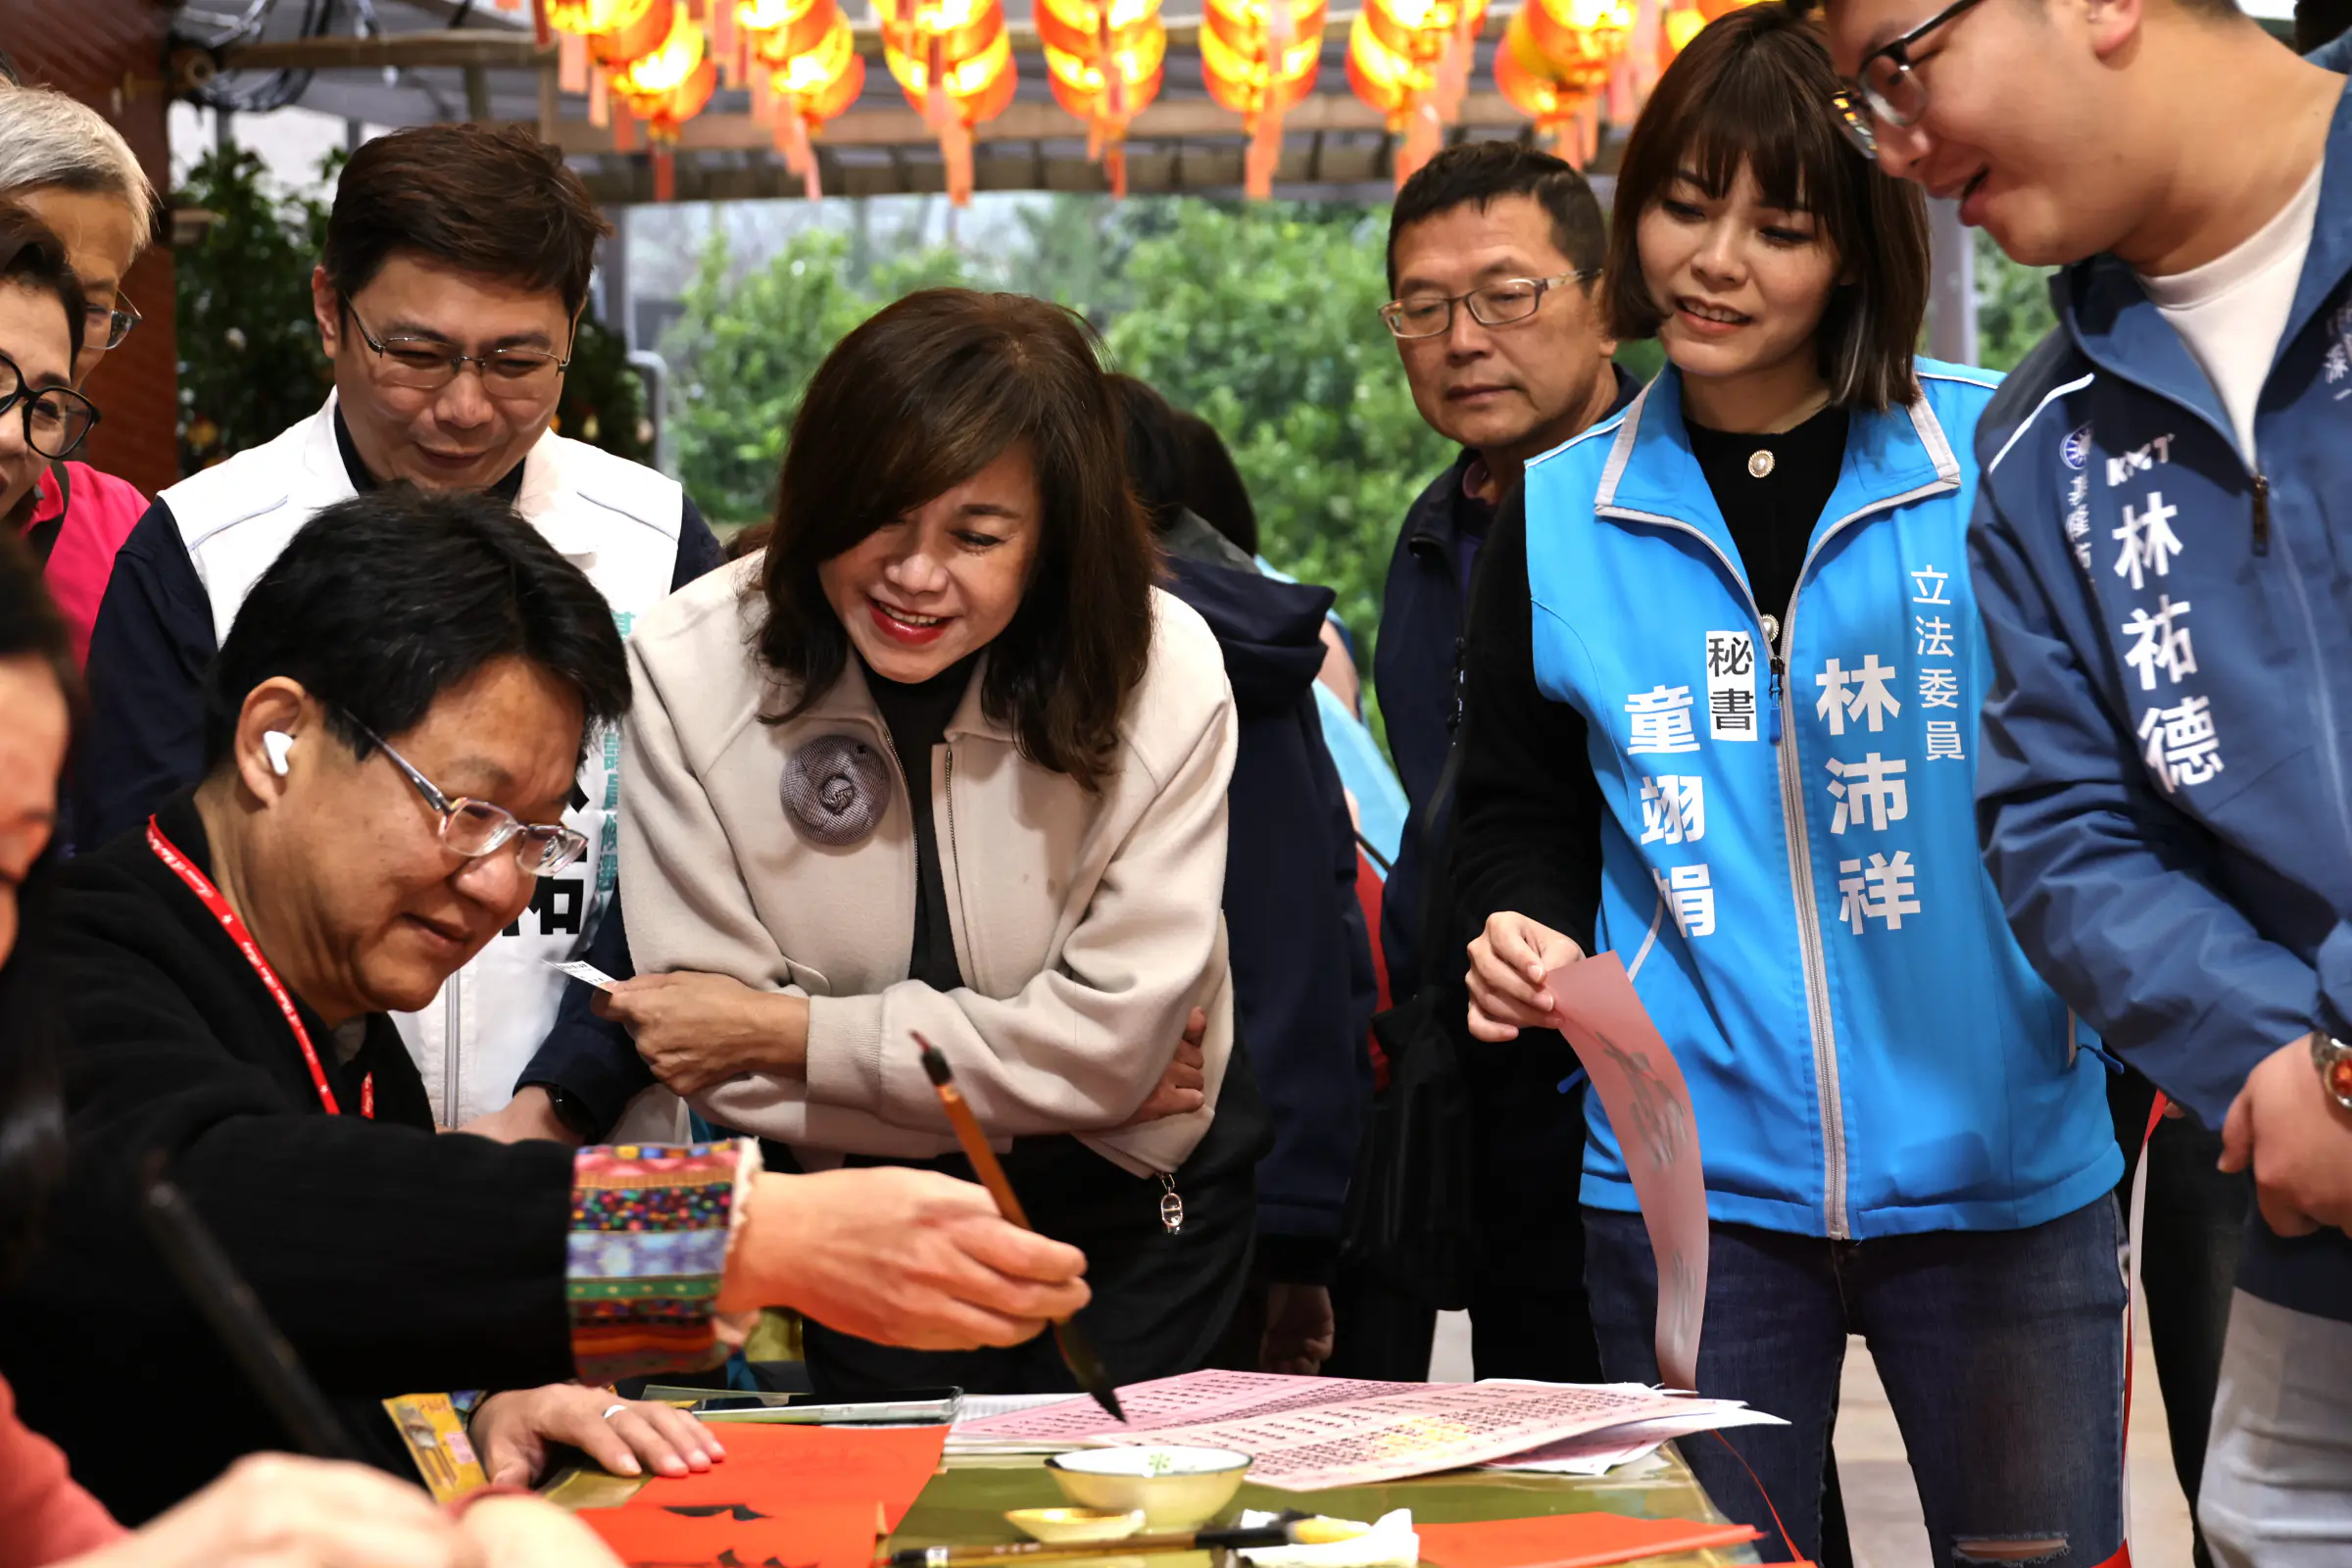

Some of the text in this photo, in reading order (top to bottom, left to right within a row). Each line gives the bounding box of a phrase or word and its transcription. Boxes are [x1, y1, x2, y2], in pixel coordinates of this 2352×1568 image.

[1708, 637, 1754, 731] 秘書
[1910, 564, 1966, 761] 立法委員
[2111, 491, 2225, 794] 林祐德
[1815, 654, 1921, 935] 林沛祥
